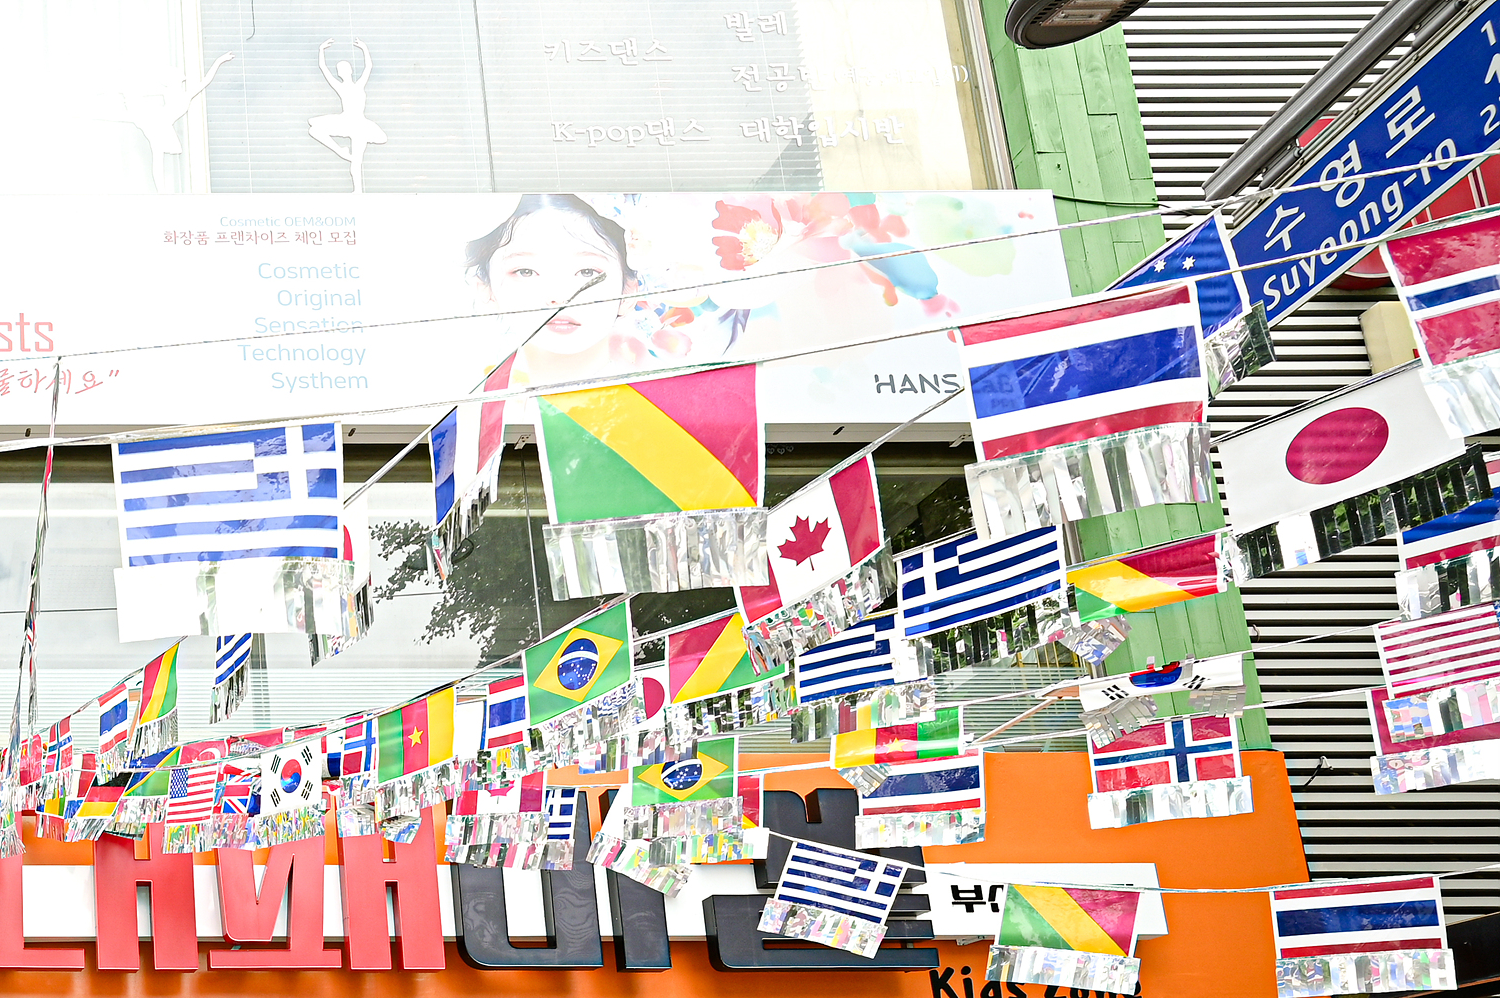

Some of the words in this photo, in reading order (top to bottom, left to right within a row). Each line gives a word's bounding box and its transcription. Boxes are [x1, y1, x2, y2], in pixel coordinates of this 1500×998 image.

[723, 11, 788, 42] 발레
[544, 37, 673, 67] 키즈댄스
[550, 117, 711, 147] K-pop댄스
[739, 115, 905, 149] 대학입시반
[1263, 86, 1436, 251] 수영로
[220, 216, 281, 227] Cosmetic
[284, 216, 356, 227] OEM&ODM
[1263, 138, 1457, 311] Suyeong-ro
[164, 230, 210, 245] 화장품
[295, 230, 323, 245] 체인
[328, 230, 357, 245] 모집
[257, 262, 360, 279] Cosmetic
[277, 289, 362, 311] Original
[254, 316, 364, 334] Sensation
[237, 343, 367, 366] Technology
[271, 371, 369, 393] Systhem
